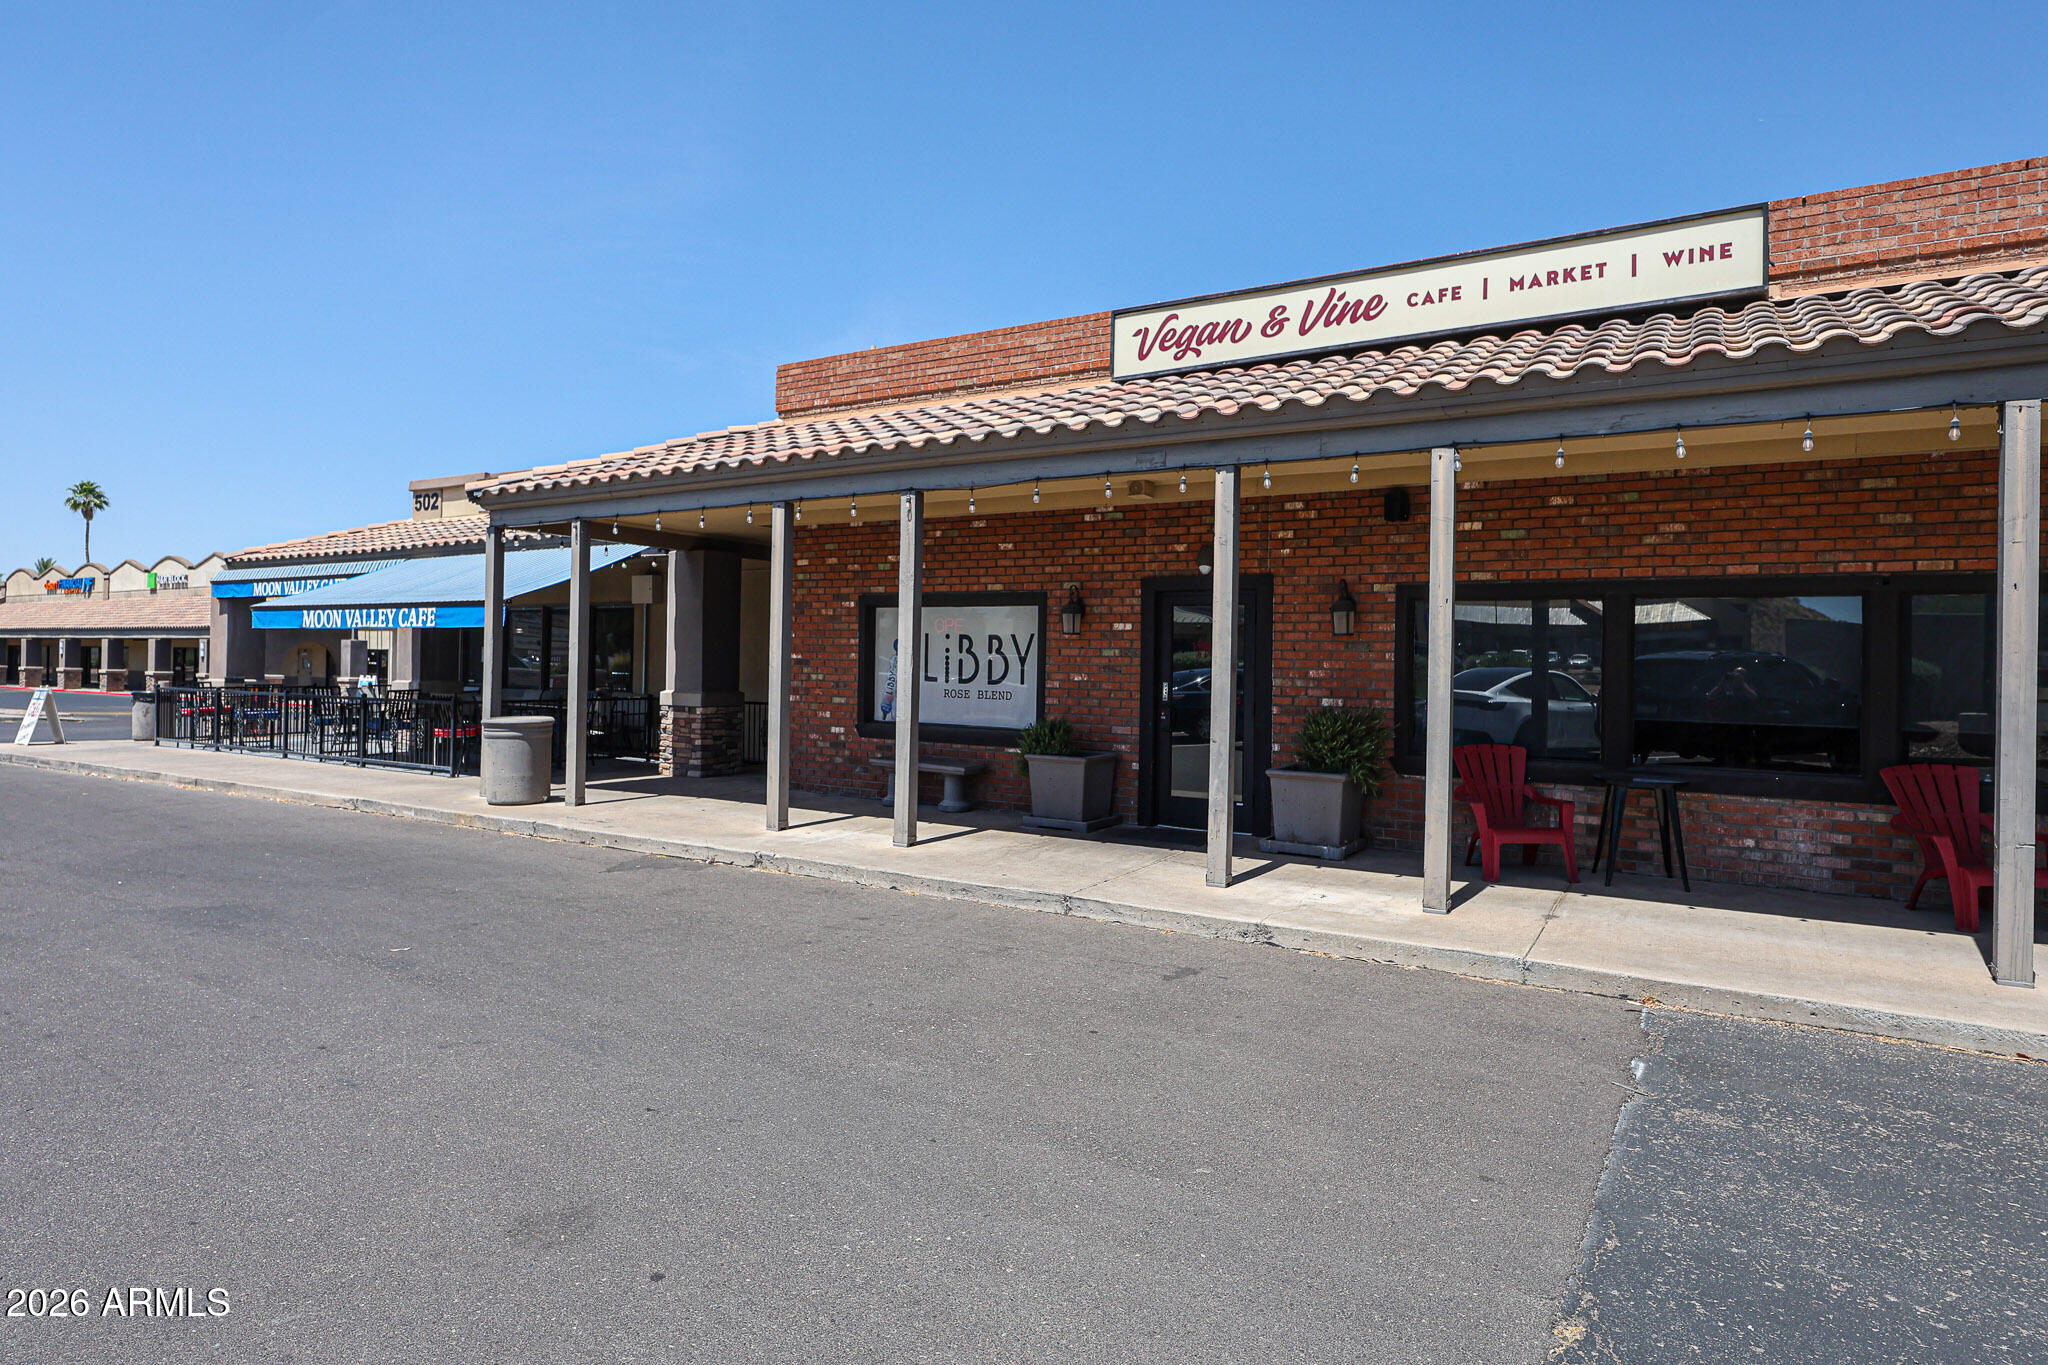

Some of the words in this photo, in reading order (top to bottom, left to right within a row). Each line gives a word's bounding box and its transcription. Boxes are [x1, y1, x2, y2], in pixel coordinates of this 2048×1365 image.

[1132, 313, 1252, 361] Vegan
[1260, 305, 1290, 338] &
[1298, 288, 1388, 336] Vine
[1406, 285, 1462, 308] CAFE
[1509, 262, 1608, 292] MARKET
[1662, 242, 1733, 268] WINE
[414, 492, 439, 512] 502
[253, 581, 283, 597] MOON
[302, 609, 343, 628] MOON
[344, 608, 397, 628] VALLEY
[398, 607, 437, 627] CAFE
[943, 688, 971, 699] ROSE
[977, 690, 1013, 701] BLEND
